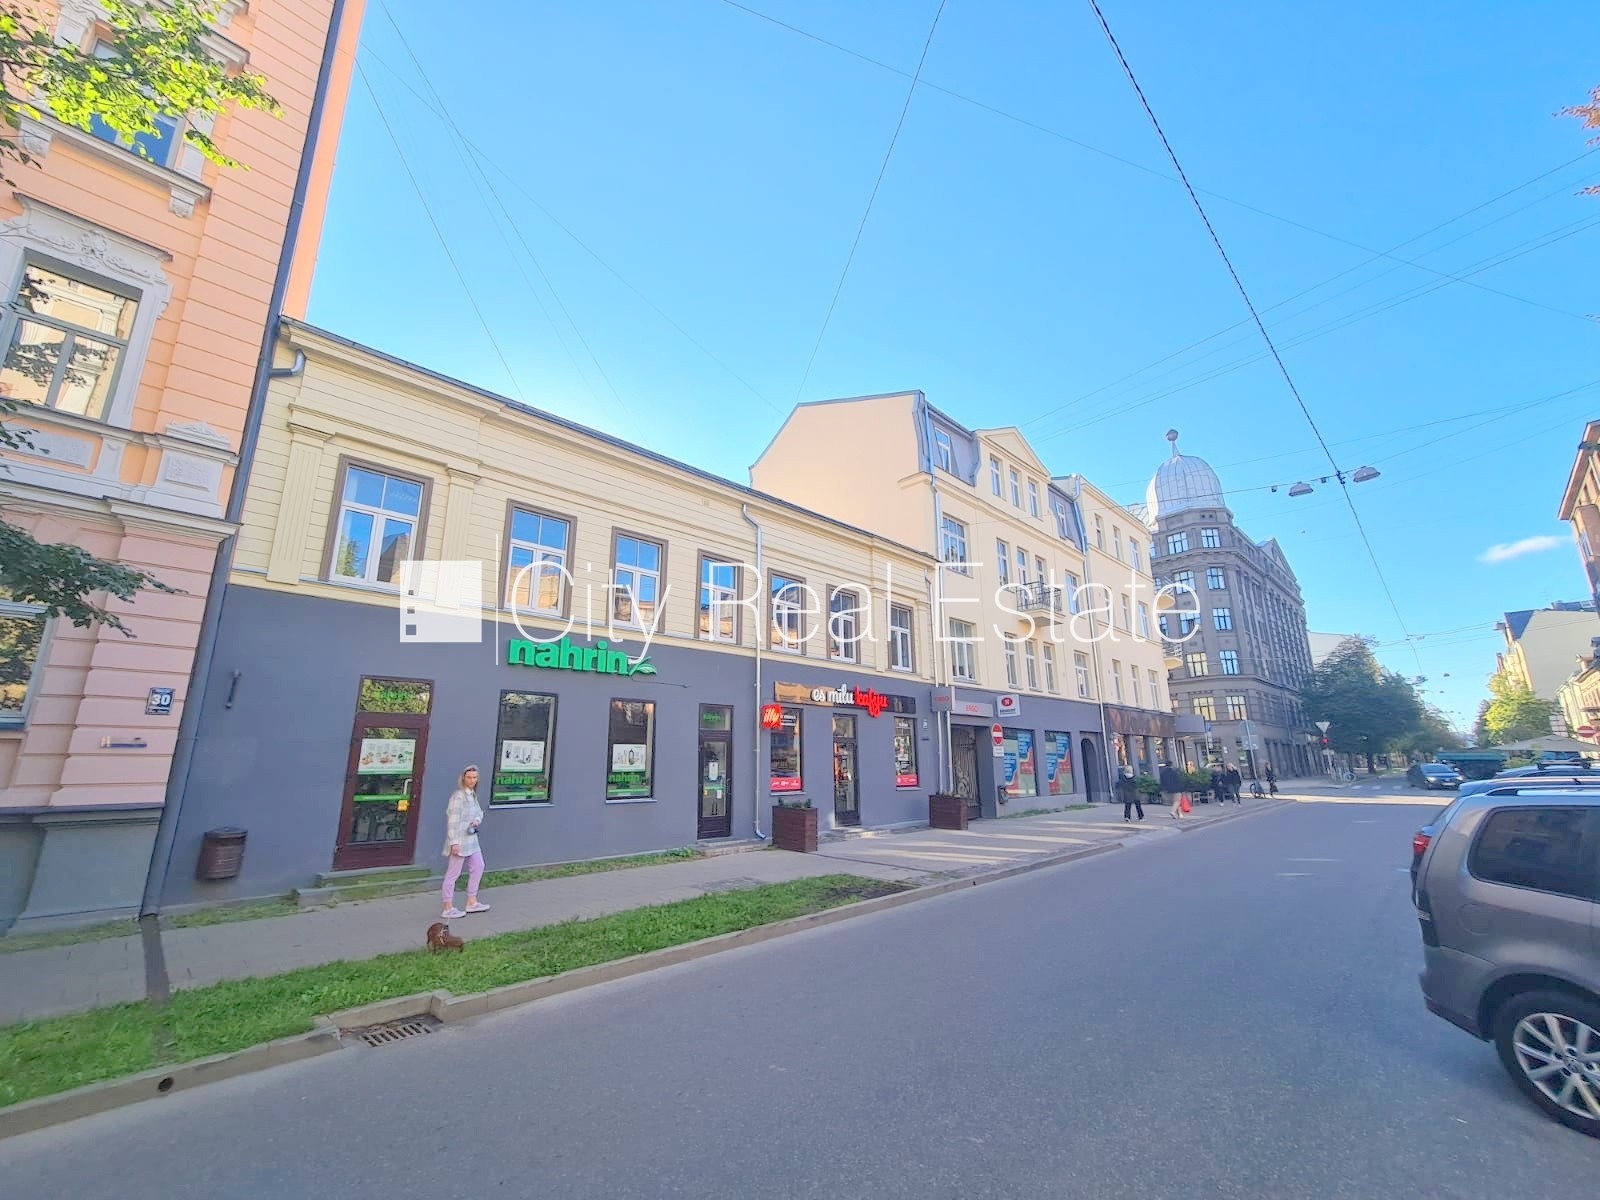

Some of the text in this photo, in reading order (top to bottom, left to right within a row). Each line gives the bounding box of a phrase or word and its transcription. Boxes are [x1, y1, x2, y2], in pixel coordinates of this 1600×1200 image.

[508, 637, 630, 676] nahrin
[151, 694, 171, 705] 30
[811, 688, 826, 702] es
[763, 707, 780, 727] illy
